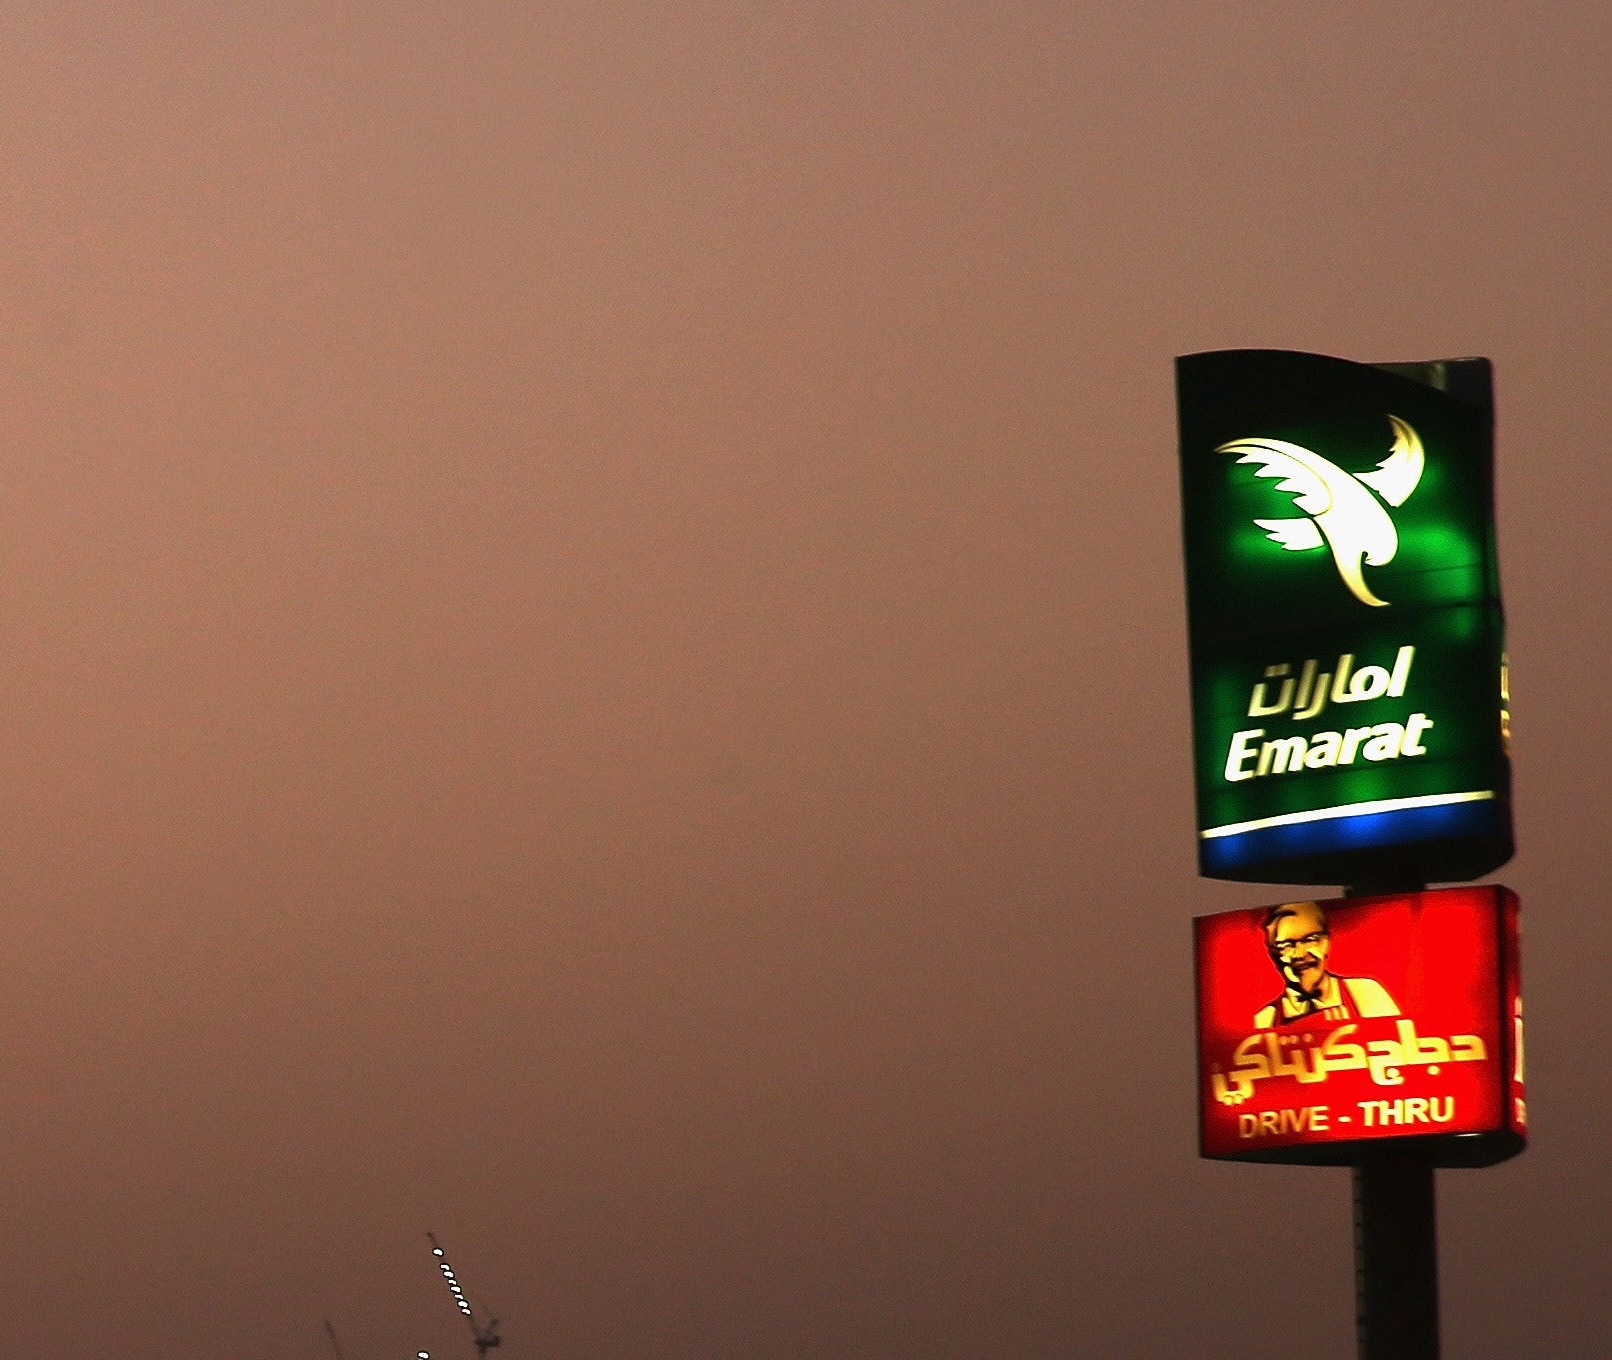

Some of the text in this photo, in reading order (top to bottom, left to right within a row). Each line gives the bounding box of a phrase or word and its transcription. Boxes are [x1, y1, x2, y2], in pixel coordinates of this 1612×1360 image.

[1224, 712, 1434, 782] Emarat
[1366, 1018, 1488, 1086] دجاج
[1238, 1105, 1329, 1138] DRIVE
[1357, 1095, 1455, 1127] THRU
